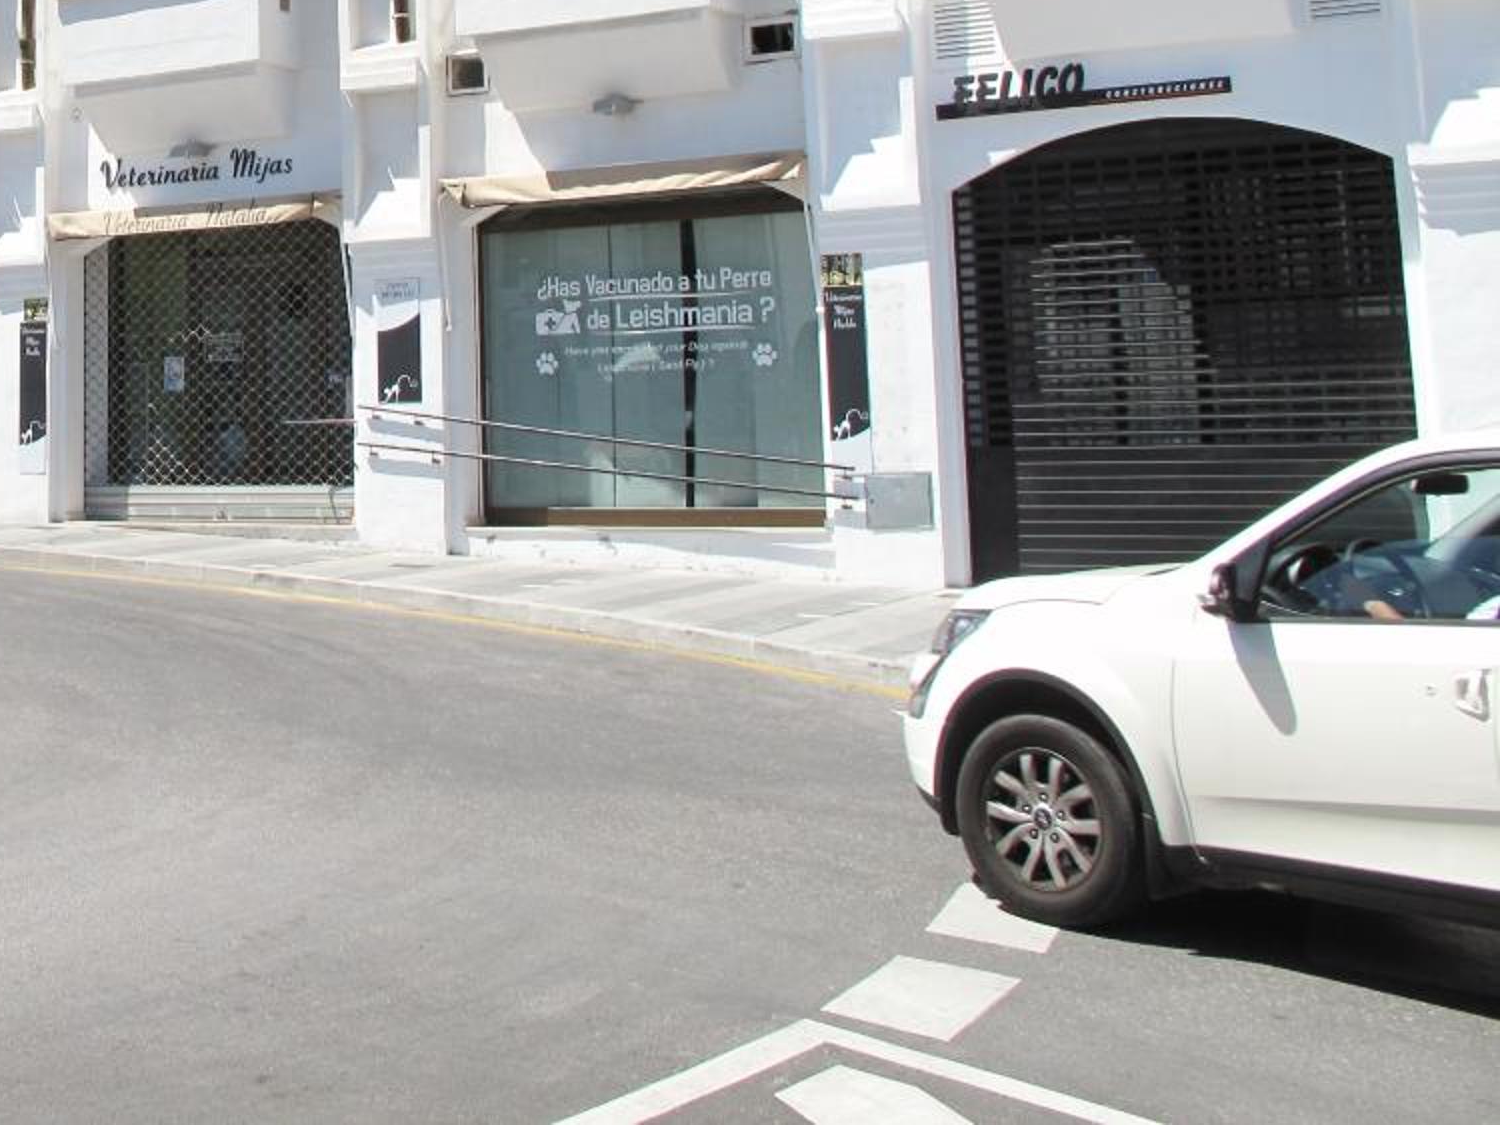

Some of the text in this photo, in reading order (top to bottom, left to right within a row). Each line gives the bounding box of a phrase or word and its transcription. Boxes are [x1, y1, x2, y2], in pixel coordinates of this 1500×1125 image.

[100, 148, 293, 189] Veterinaria Mijas
[537, 276, 581, 301] ¿Has
[585, 270, 674, 296] Vacunado
[677, 275, 691, 292] a
[695, 268, 716, 291] tu
[586, 309, 611, 330] de
[615, 301, 754, 328] Leishmania
